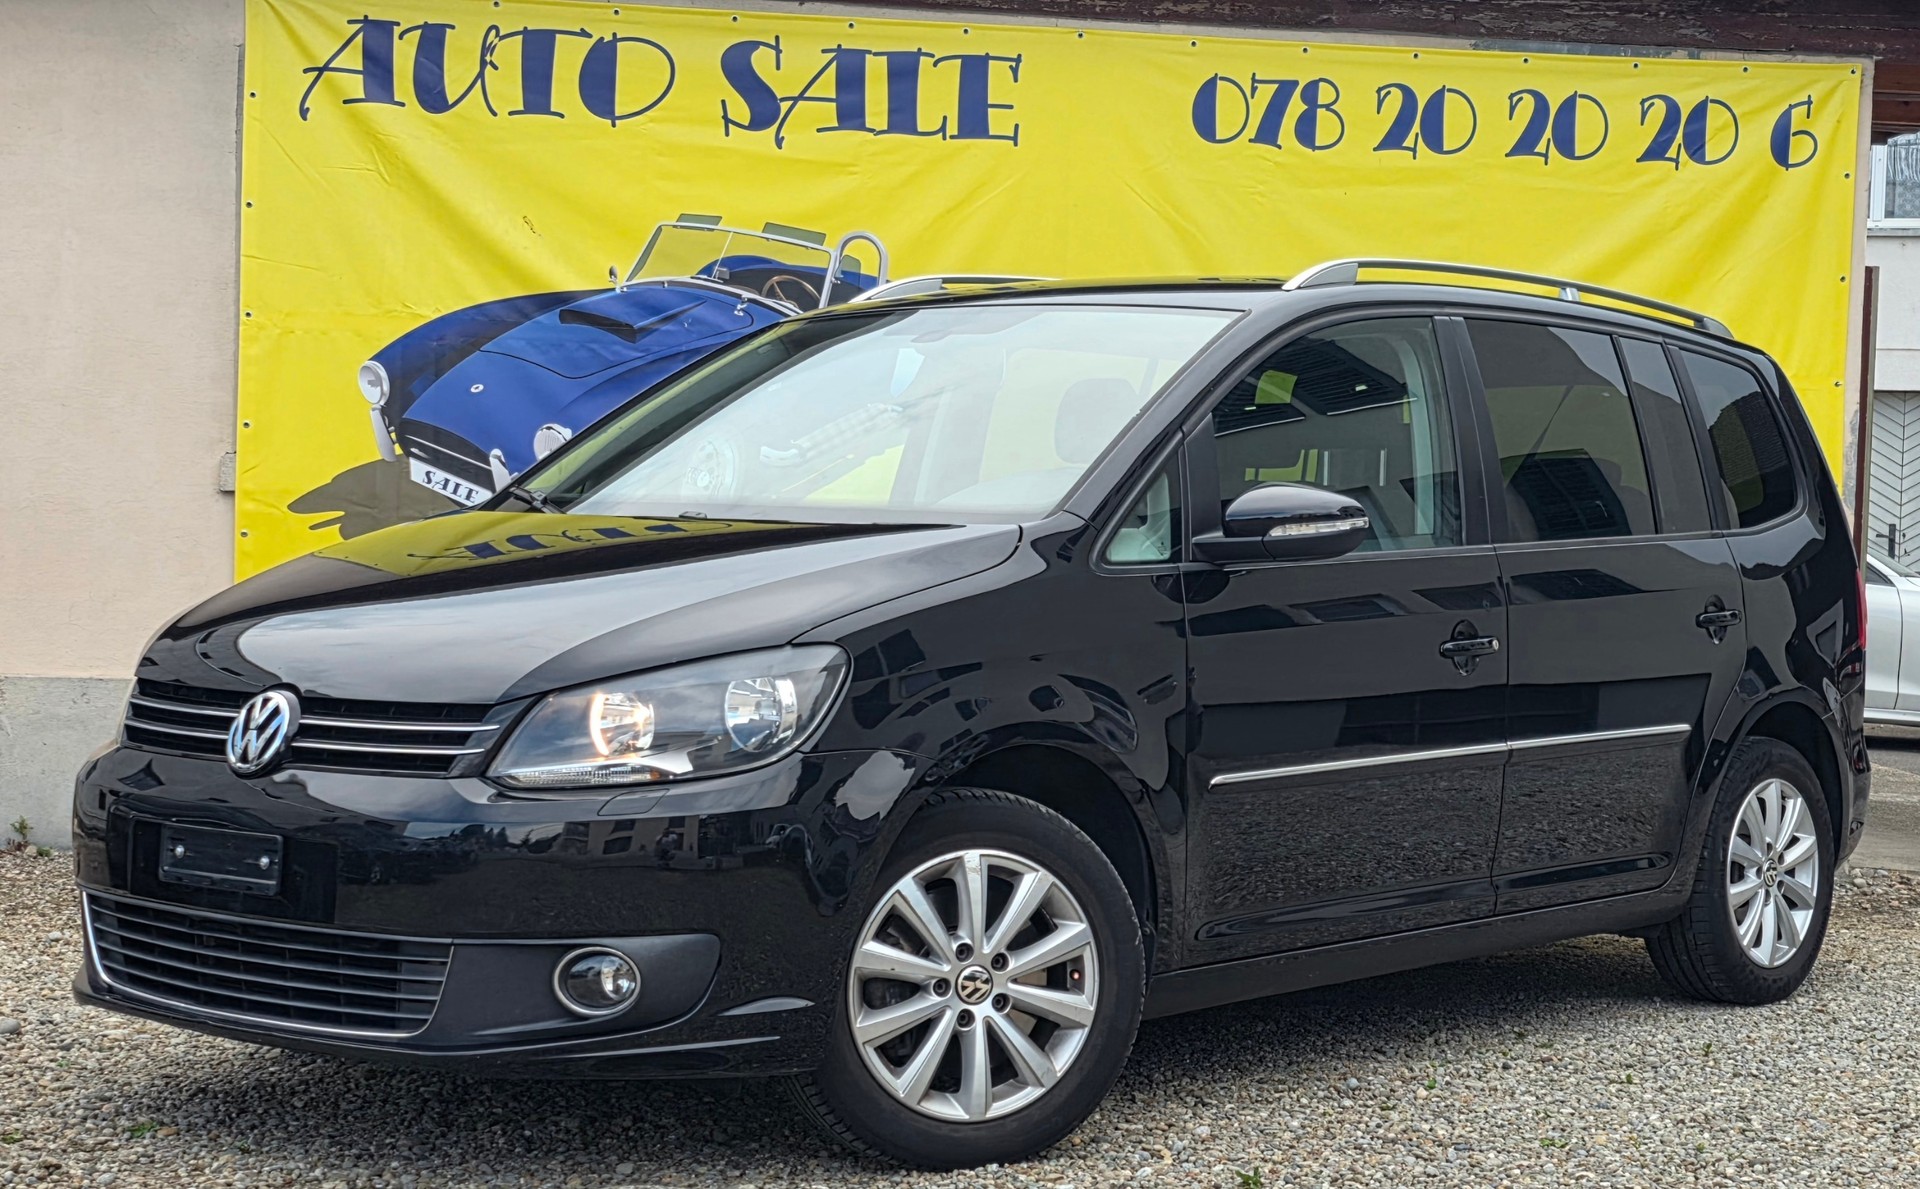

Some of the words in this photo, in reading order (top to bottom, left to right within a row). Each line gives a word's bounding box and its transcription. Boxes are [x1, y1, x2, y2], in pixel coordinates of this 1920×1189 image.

[299, 14, 675, 127] AUTO
[721, 35, 1022, 149] SALE
[1191, 72, 1346, 150] 078
[1373, 82, 1478, 160] 20
[1505, 88, 1609, 165] 20
[1636, 93, 1739, 171] 20
[1770, 94, 1818, 171] 6
[422, 470, 479, 504] SALE
[226, 690, 290, 774] VW
